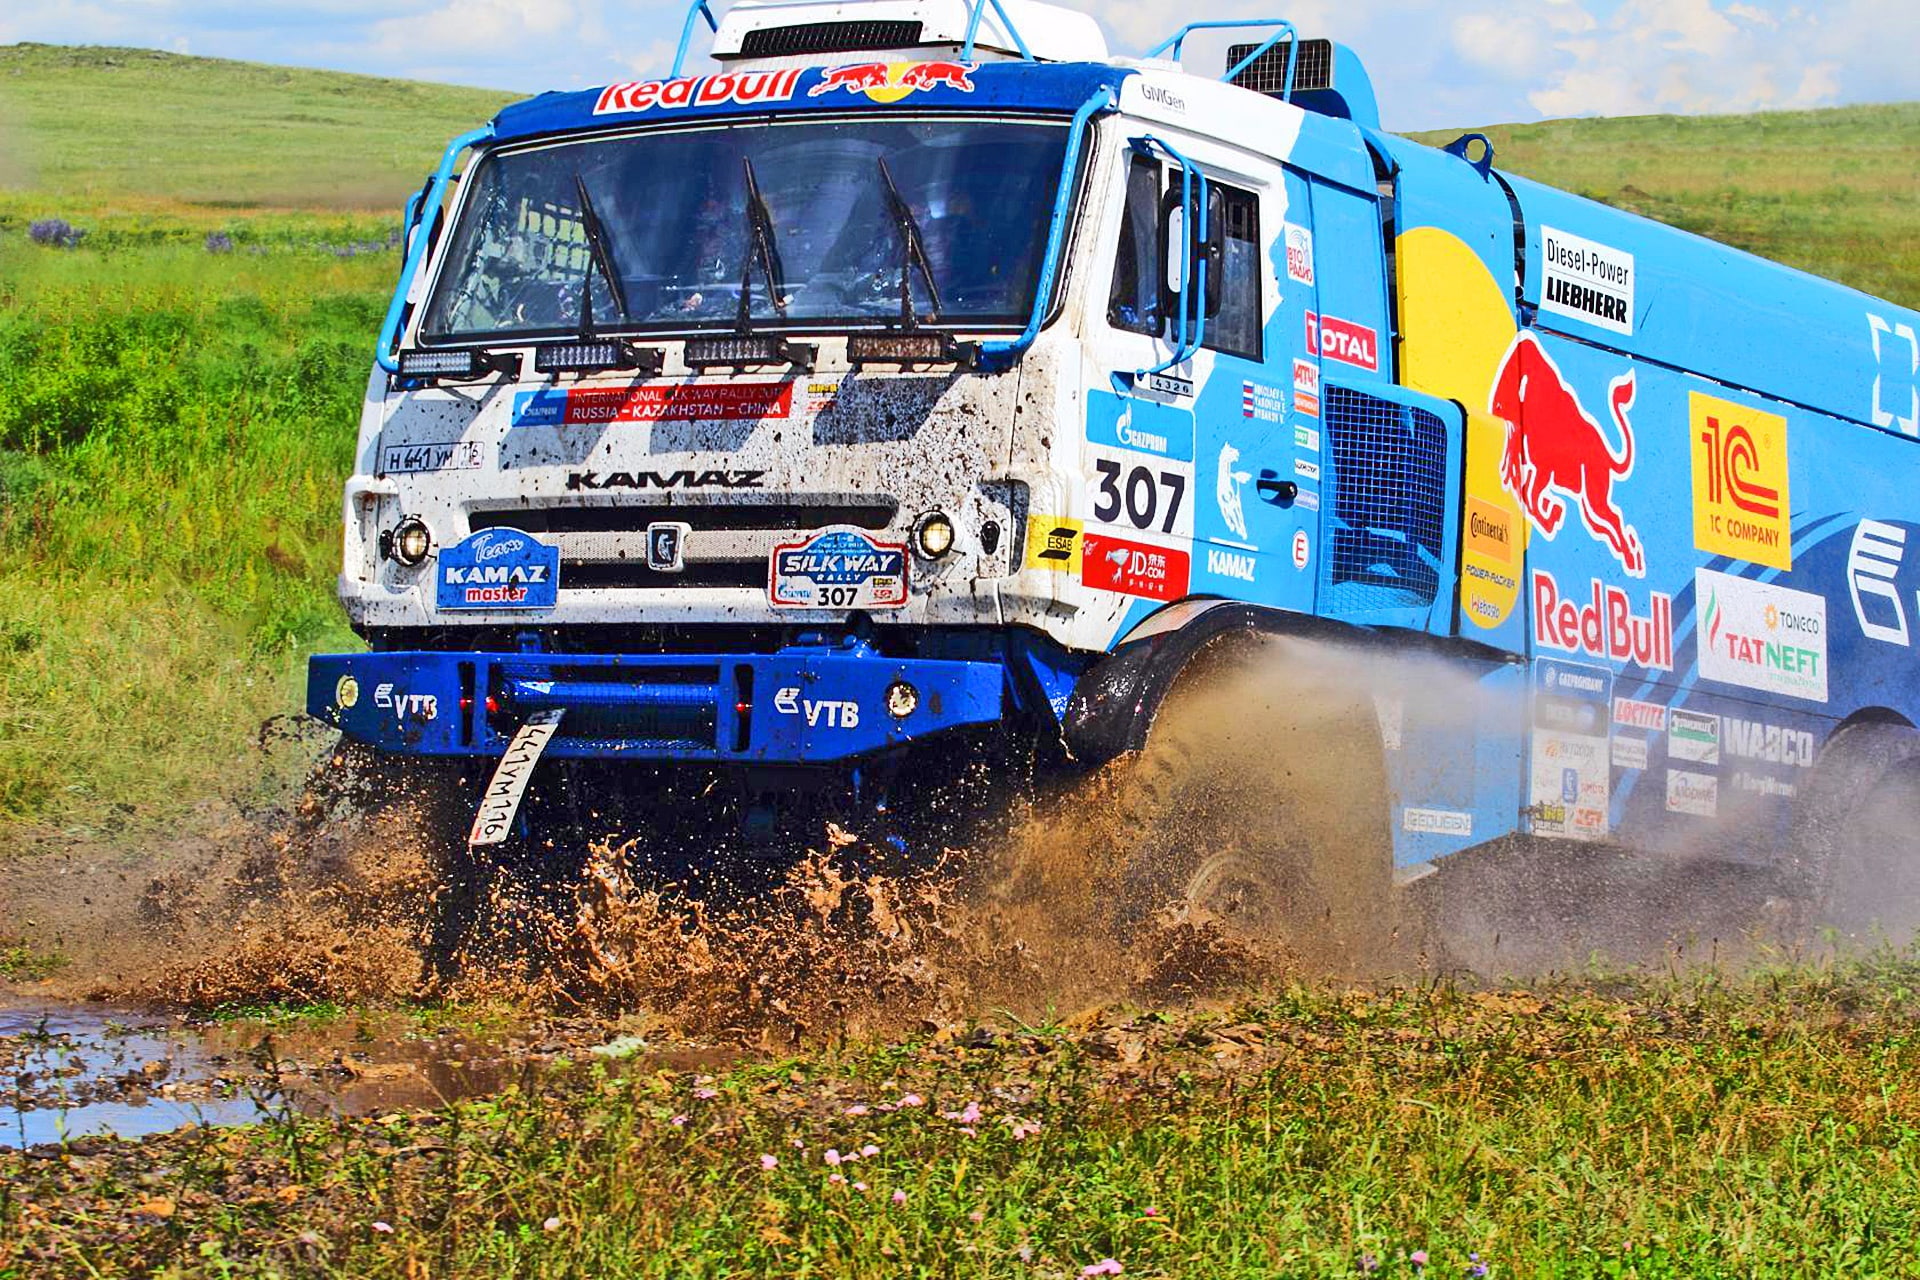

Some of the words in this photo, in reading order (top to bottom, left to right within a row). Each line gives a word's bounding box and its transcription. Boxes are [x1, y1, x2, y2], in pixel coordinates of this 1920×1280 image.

[596, 76, 700, 113] Red
[699, 67, 803, 105] Bull
[1547, 238, 1628, 286] Diesel-Power
[1546, 276, 1627, 324] LIEBHERR
[1307, 318, 1375, 365] TOTAL
[571, 406, 620, 420] RUSSIA
[632, 403, 724, 418] KAZAKHSTAN
[738, 401, 782, 415] CHINA
[573, 389, 662, 405] INTERNATIONAL
[566, 470, 766, 491] KAMAZ
[1094, 457, 1185, 534] 307
[1048, 536, 1073, 551] ESAB
[1726, 518, 1780, 548] COMPANY
[471, 533, 525, 564] Team
[1295, 537, 1305, 562] E
[445, 565, 547, 584] KAMAZ
[784, 554, 841, 573] SILK
[843, 554, 896, 573] WAY
[816, 573, 861, 582] RALLY
[1207, 550, 1256, 583] KAMAZ
[466, 585, 528, 603] master
[817, 587, 858, 607] 307
[1533, 570, 1605, 656] Red
[1606, 587, 1673, 669] Bull
[1725, 632, 1820, 677] TATNEFT
[394, 694, 438, 720] VTB
[802, 699, 859, 728] VTB
[1615, 700, 1665, 729] LOCTITE
[1722, 716, 1814, 768] WABCO
